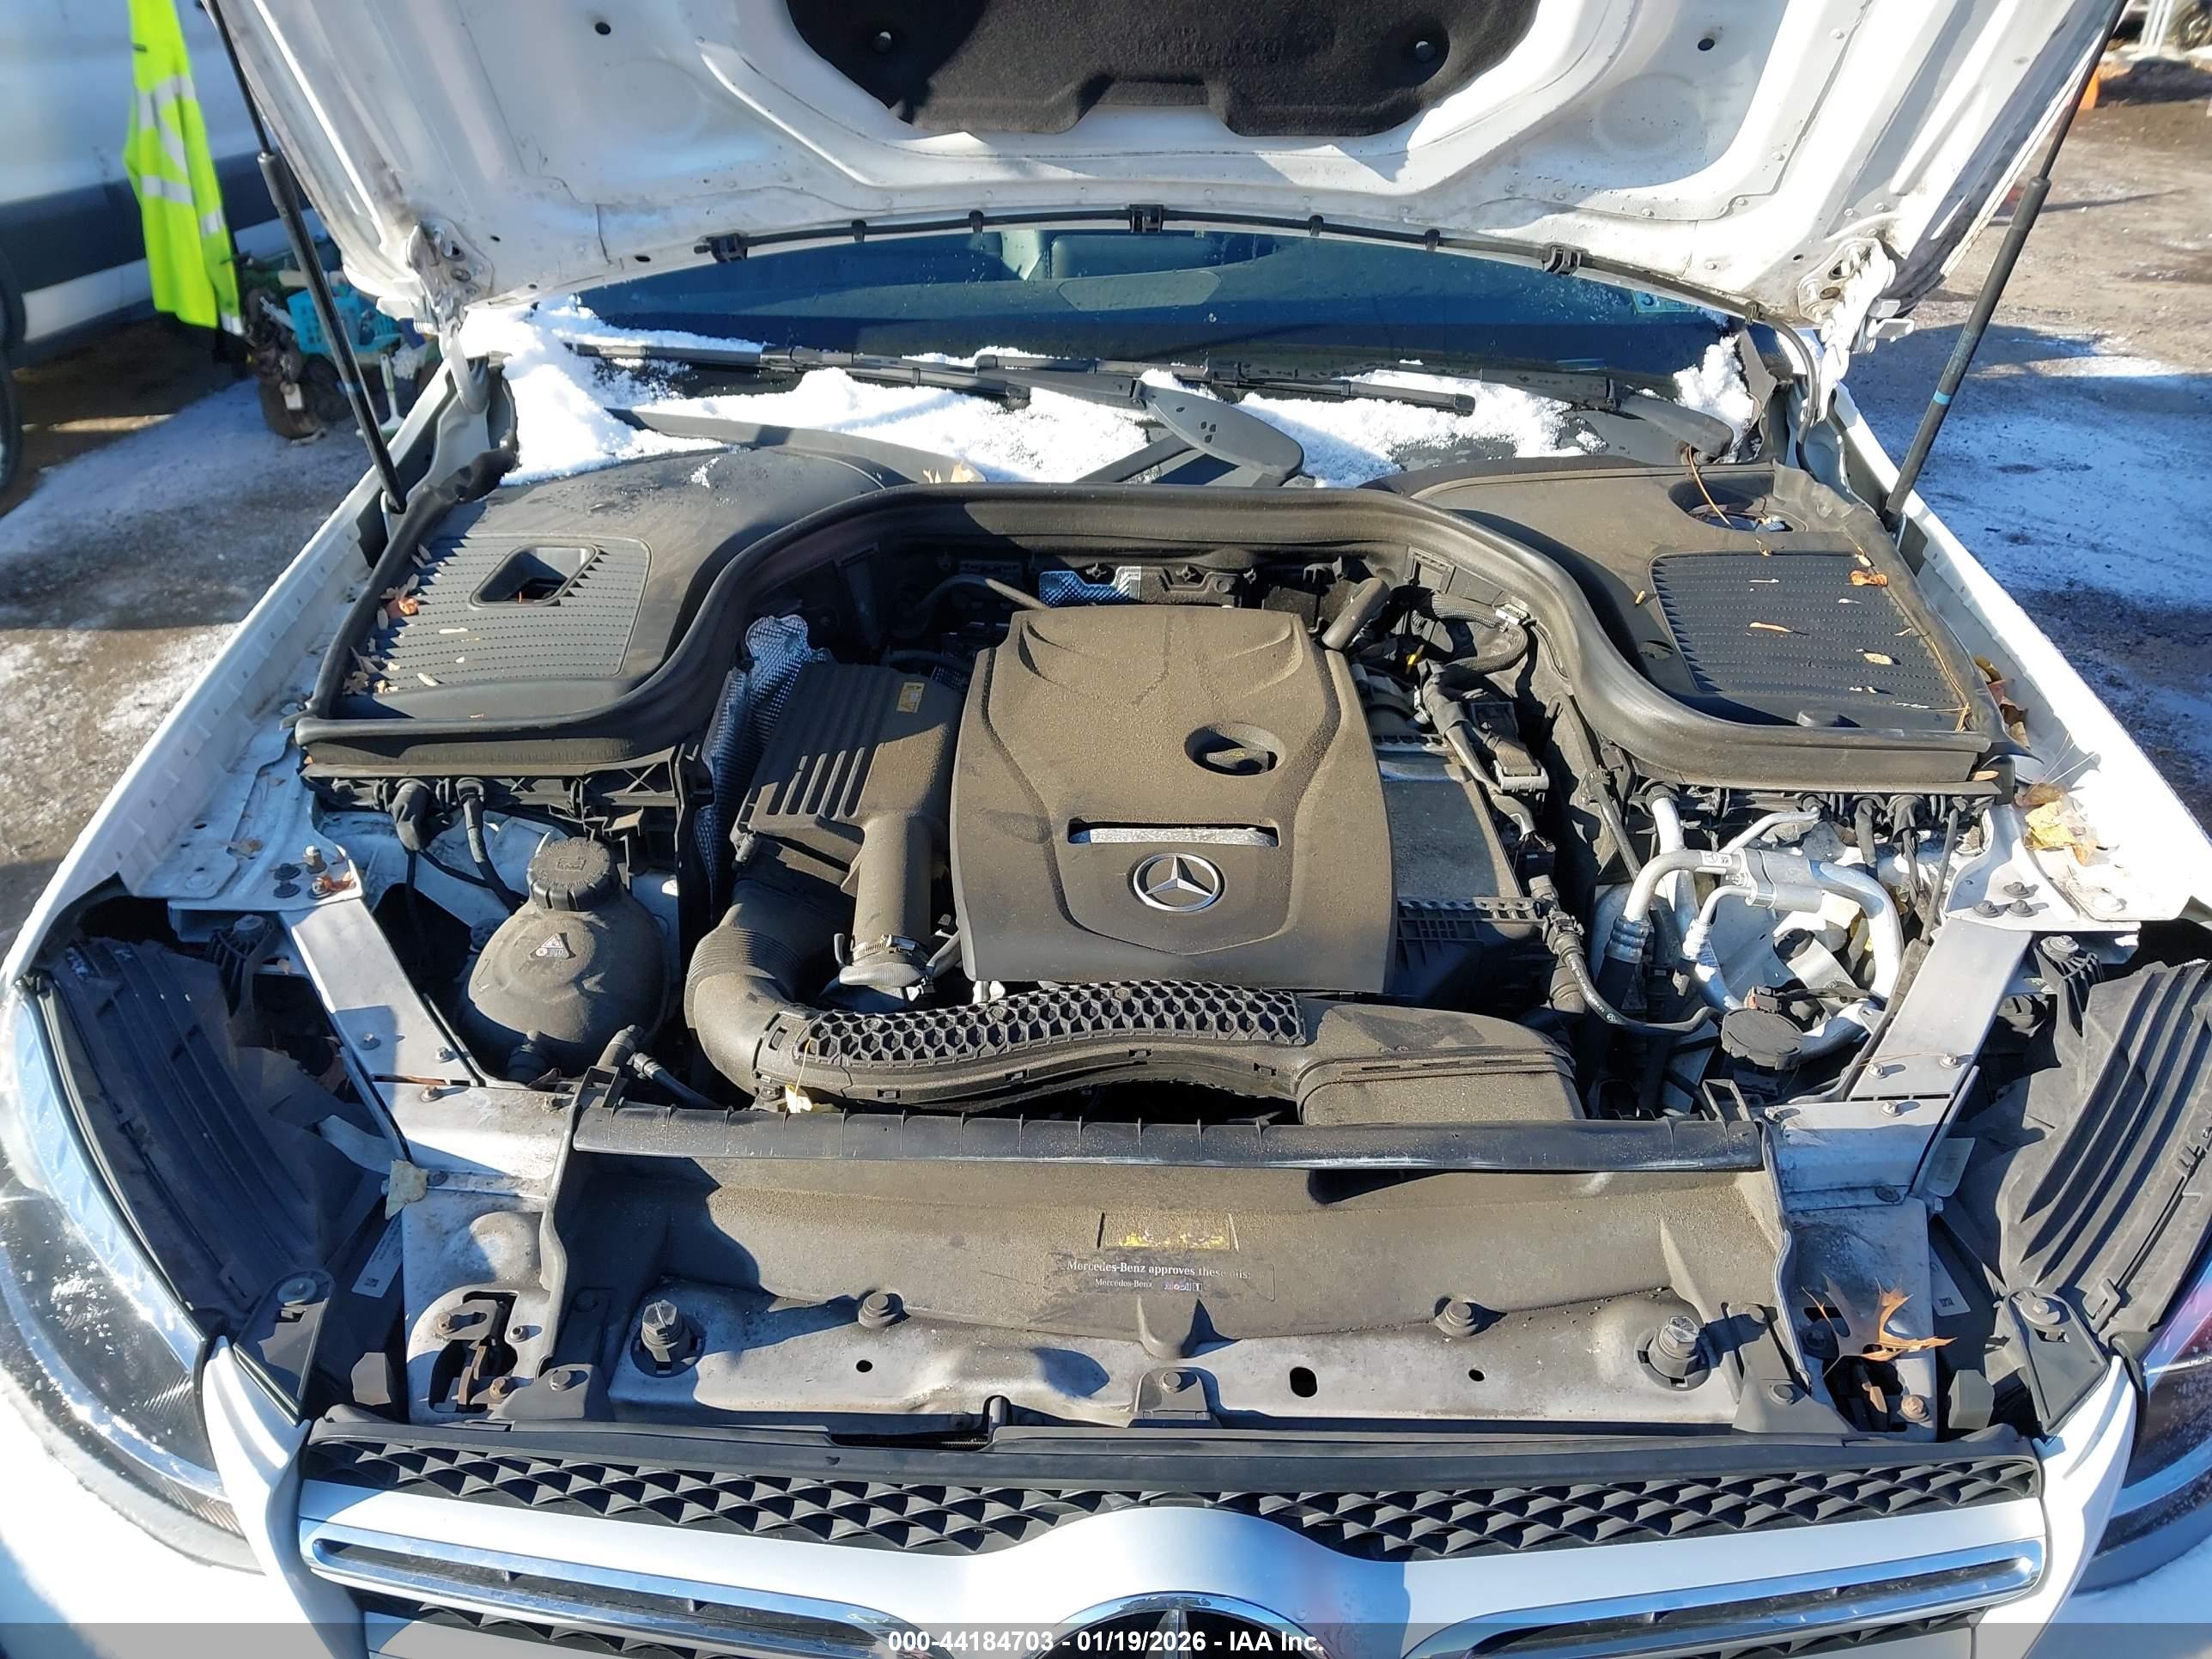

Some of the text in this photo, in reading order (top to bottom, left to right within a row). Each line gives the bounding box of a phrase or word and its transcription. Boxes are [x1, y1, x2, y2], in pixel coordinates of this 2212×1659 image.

[1066, 1260, 1146, 1273] Mercedes-Benz
[1148, 1265, 1196, 1277] approves
[1199, 1267, 1225, 1278] these
[1095, 1278, 1152, 1288] Mercedes-Benz
